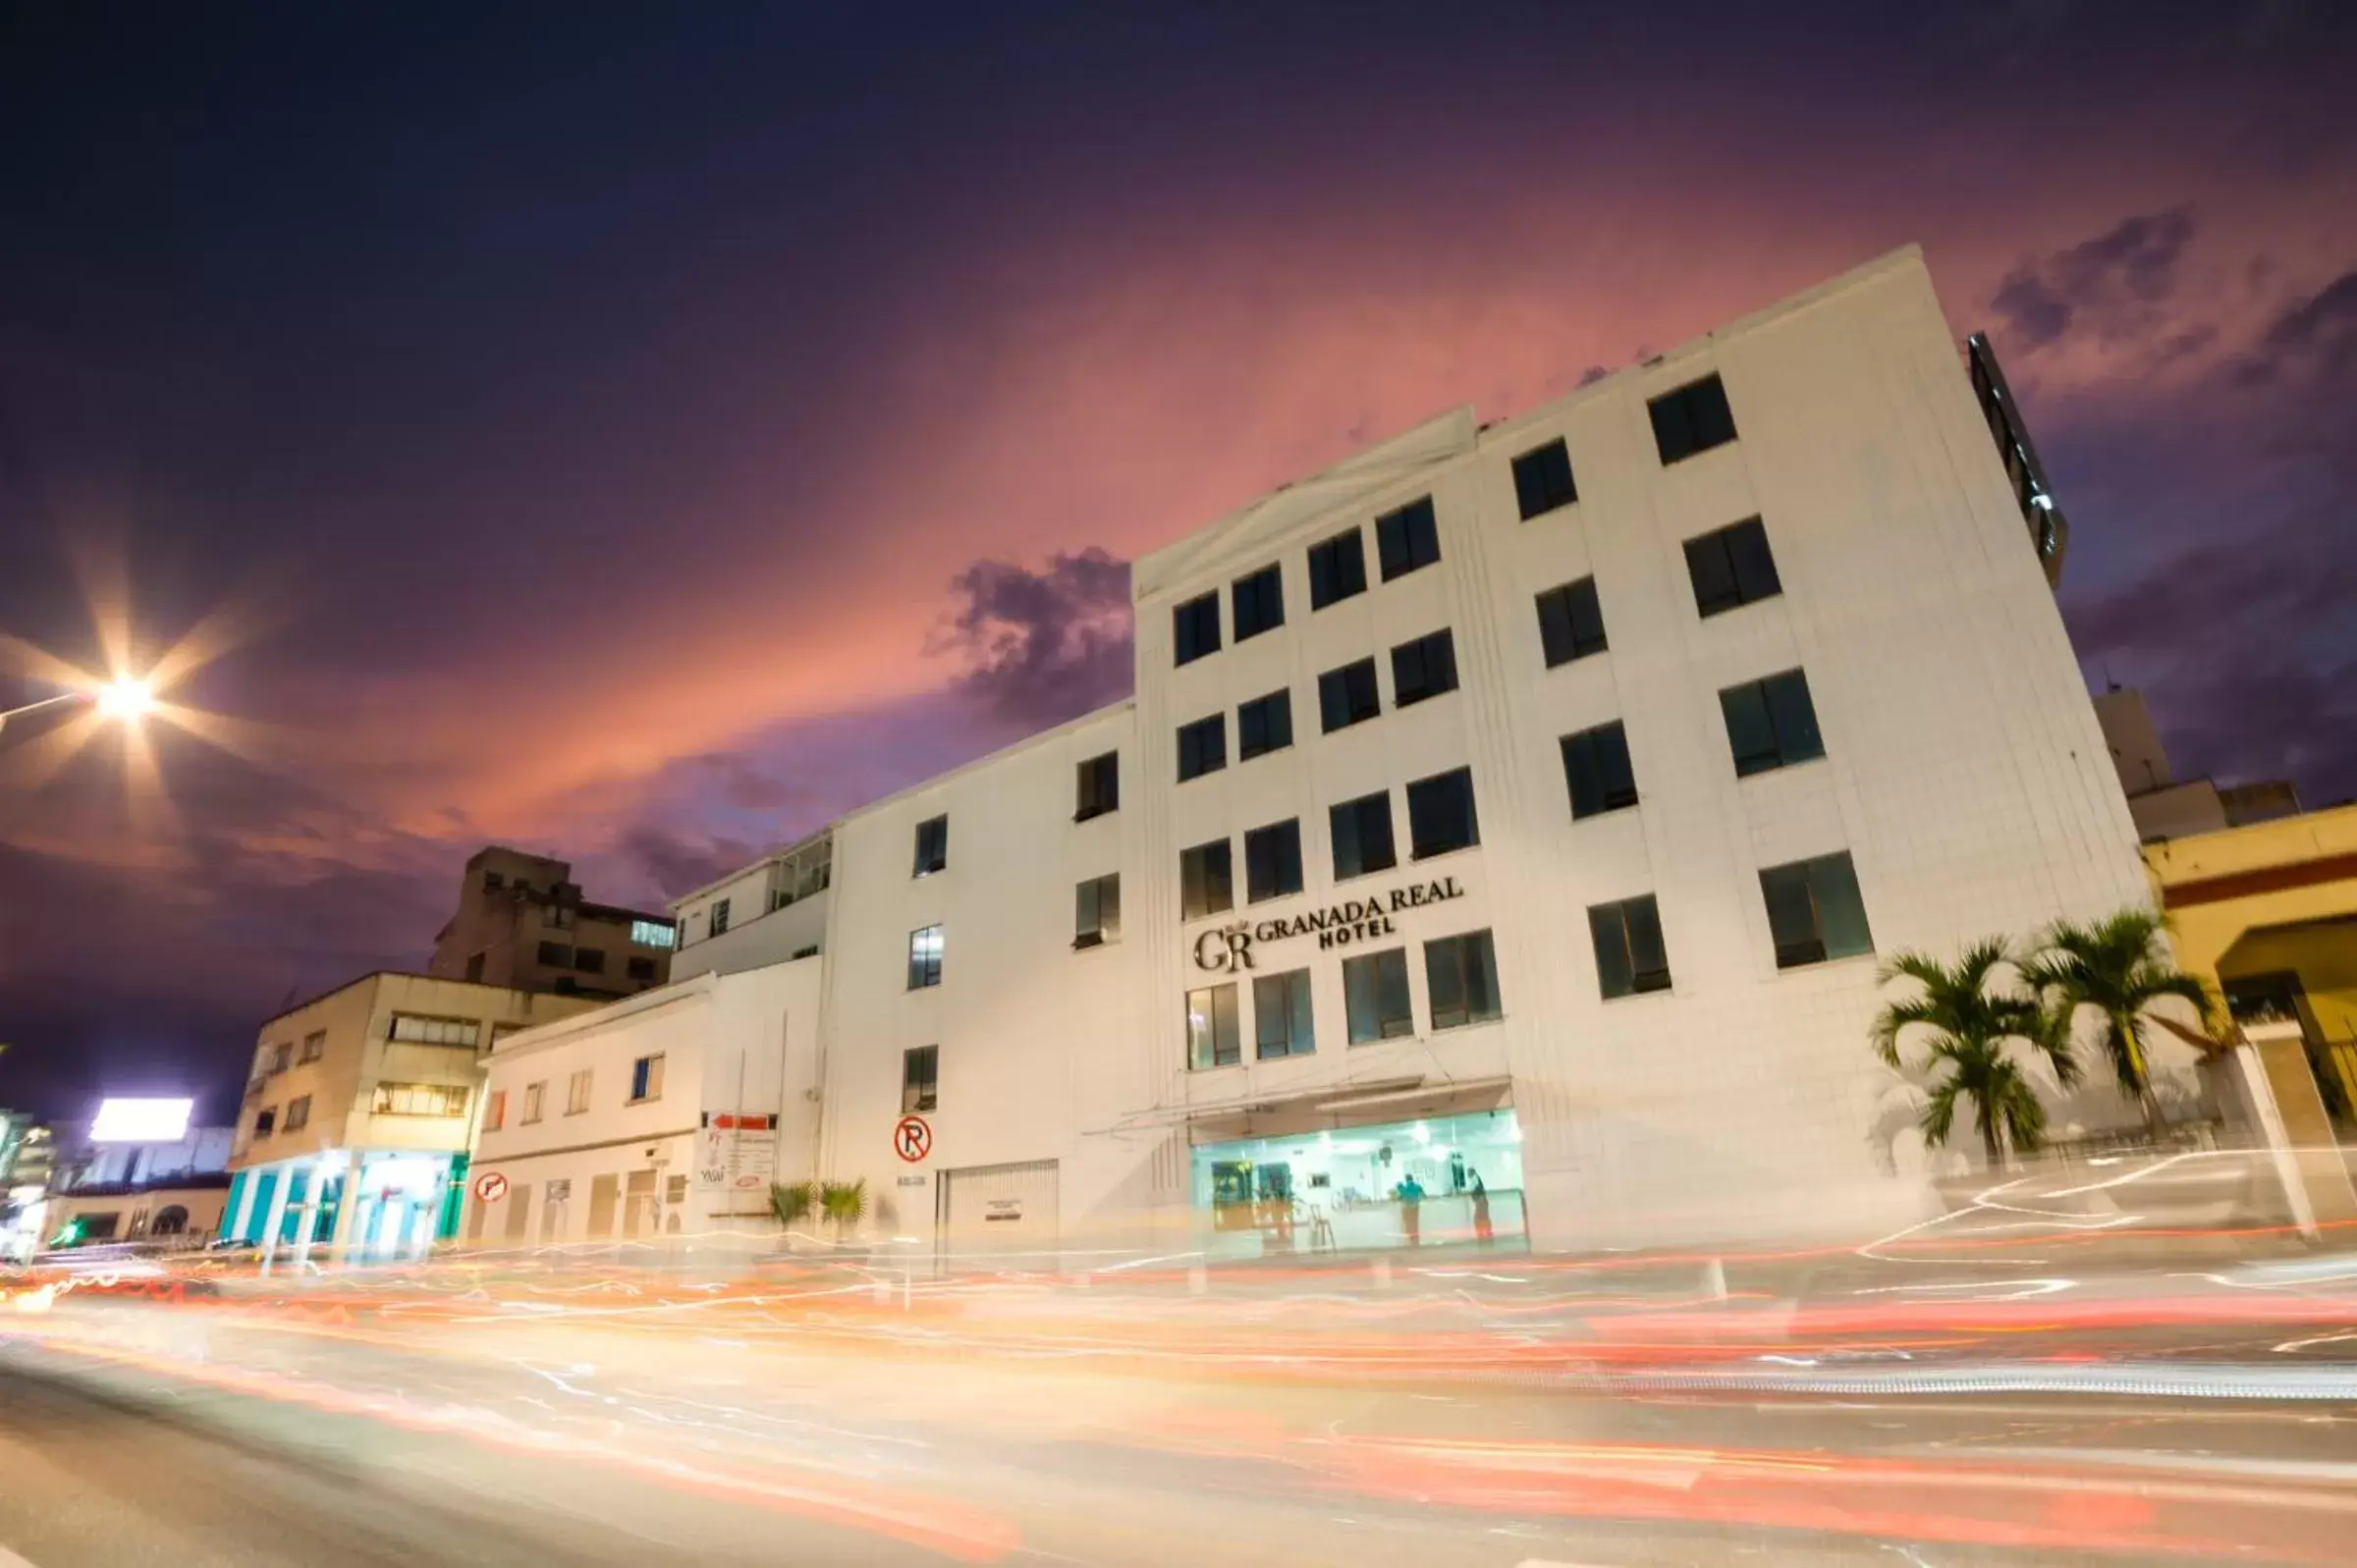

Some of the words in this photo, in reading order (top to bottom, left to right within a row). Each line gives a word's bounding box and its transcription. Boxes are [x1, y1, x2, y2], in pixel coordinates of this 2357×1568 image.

[1255, 897, 1384, 943] GRANADA
[1389, 877, 1464, 912] REAL
[1319, 916, 1396, 950] HOTEL
